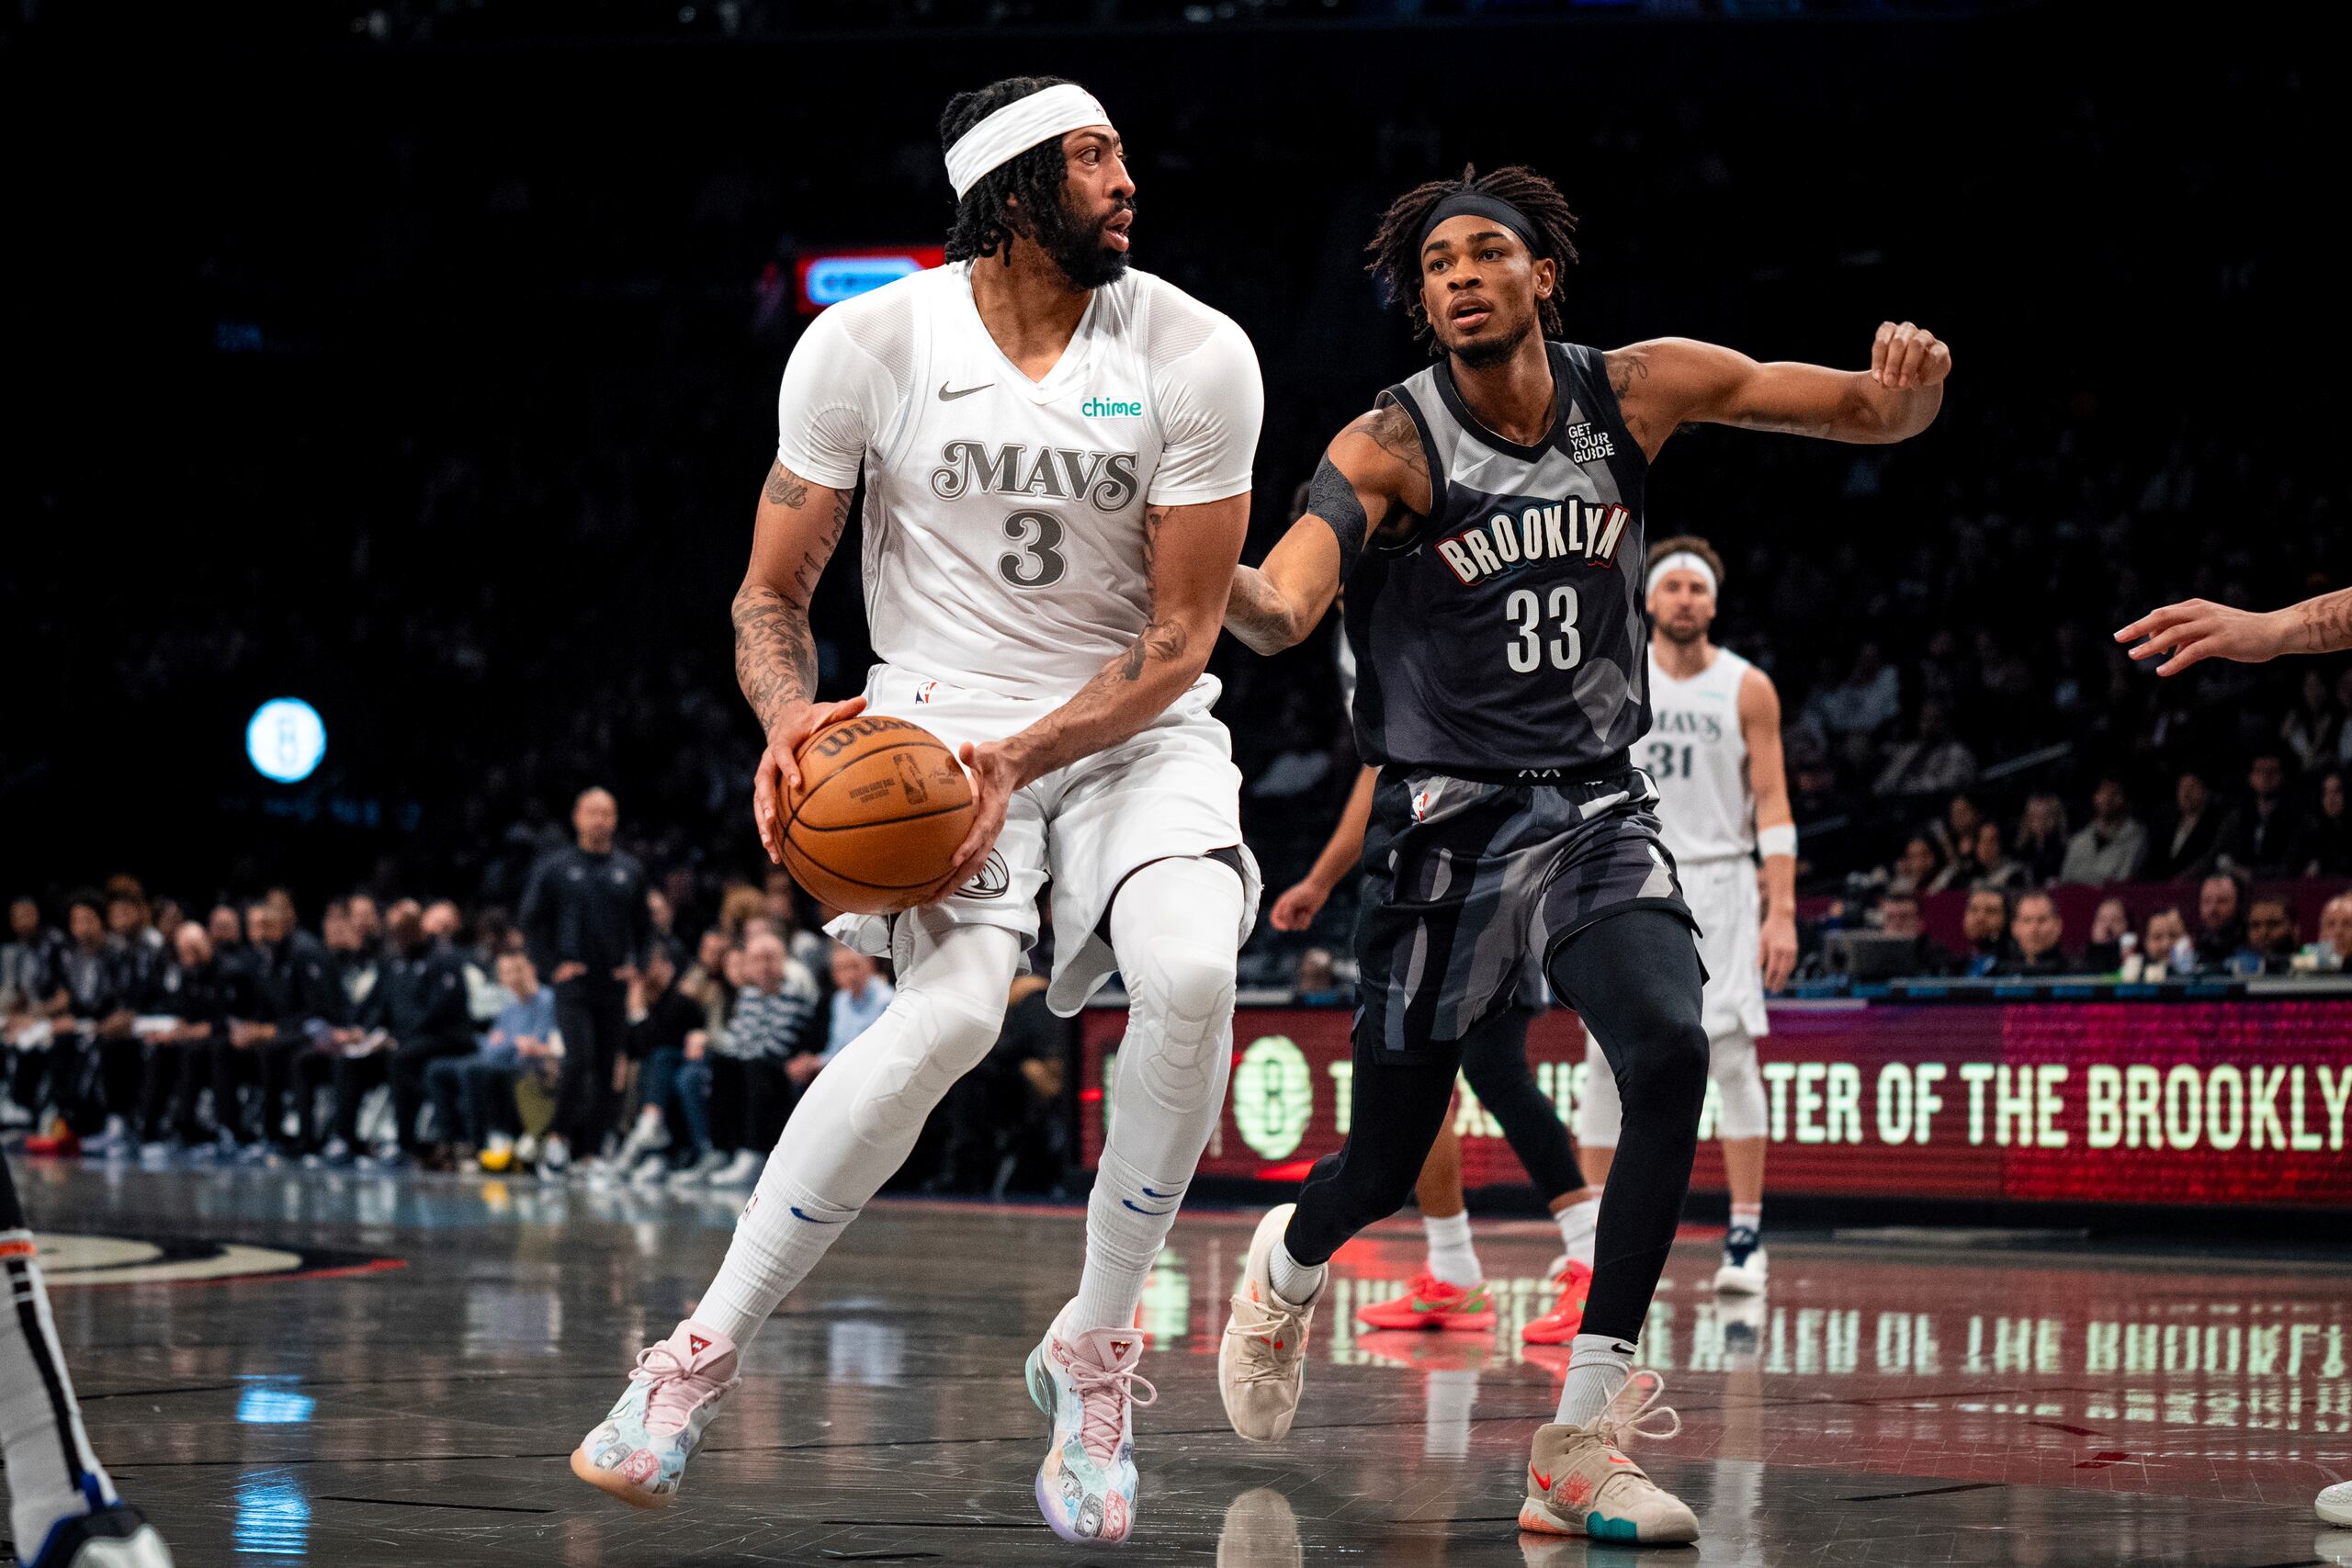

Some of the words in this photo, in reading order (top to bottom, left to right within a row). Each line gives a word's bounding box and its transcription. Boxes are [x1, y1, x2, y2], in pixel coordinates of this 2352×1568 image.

[1081, 397, 1142, 417] chime
[1568, 423, 1591, 438] GET
[1571, 432, 1610, 450] YOUR
[1573, 443, 1615, 463] GUIDE
[930, 440, 1139, 513] MAVS
[998, 508, 1067, 590] 3
[1436, 499, 1629, 583] BROOKLYN
[1506, 585, 1581, 673] 33
[1646, 741, 1692, 780] 31
[1877, 1062, 1947, 1145] OF
[1959, 1063, 2069, 1147] THE
[2087, 1064, 2352, 1151] BROOKLY
